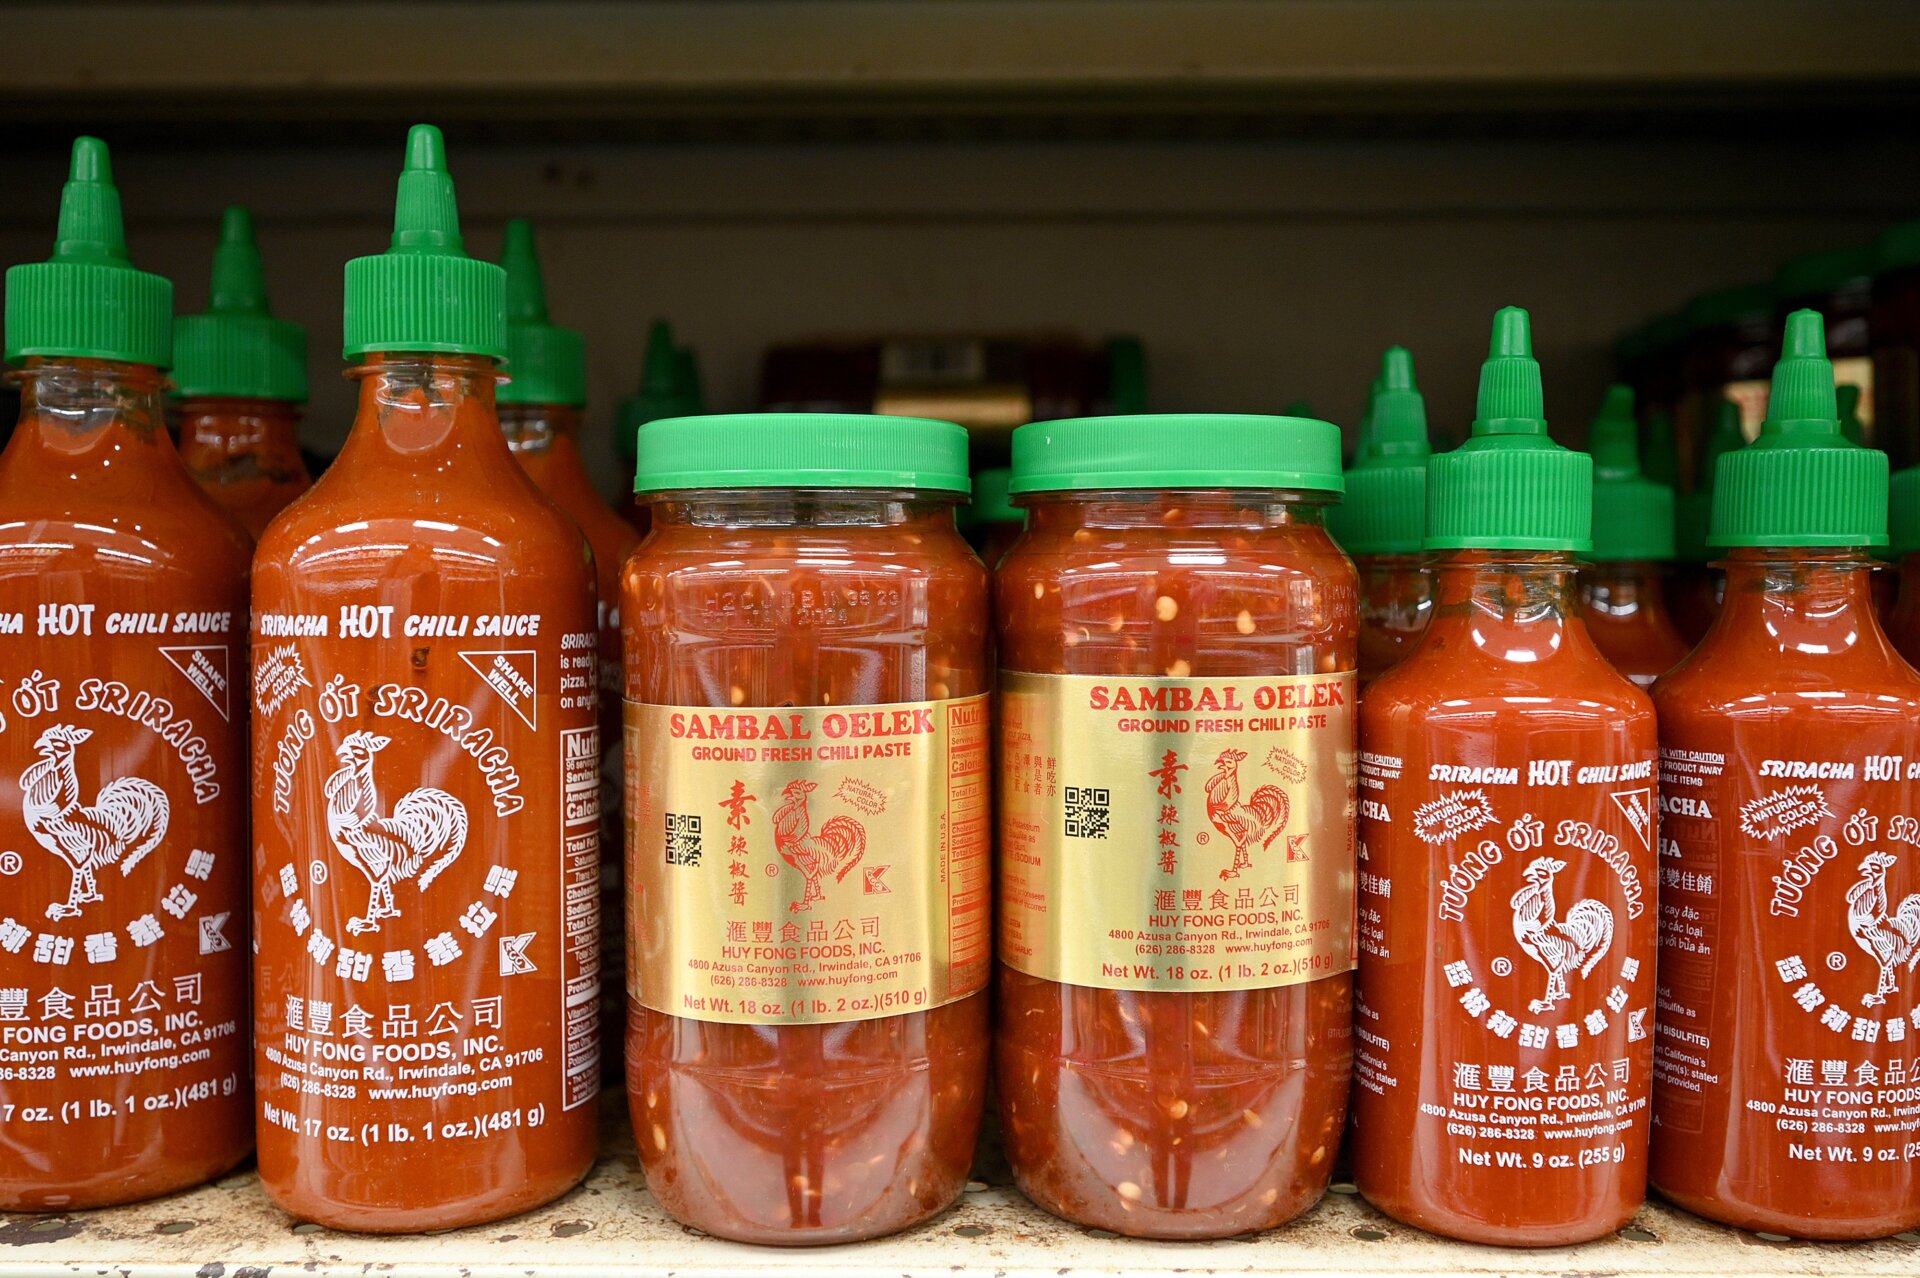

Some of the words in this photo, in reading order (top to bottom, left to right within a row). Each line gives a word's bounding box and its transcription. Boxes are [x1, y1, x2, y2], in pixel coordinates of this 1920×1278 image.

[37, 603, 95, 636] HOT
[105, 612, 169, 634] CHILI
[172, 611, 231, 633] SAUCE
[260, 614, 329, 637] SRIRACHA
[338, 604, 394, 639] HOT
[403, 615, 469, 637] CHILI
[472, 614, 541, 637] SAUCE
[560, 656, 569, 669] is
[493, 654, 534, 699] SHAKE
[487, 668, 521, 708] WELL
[1089, 686, 1244, 712] SAMBAL
[1253, 681, 1345, 710] OELEK
[560, 696, 574, 709] on
[669, 712, 812, 741] SAMBAL
[822, 708, 935, 738] OELEK
[1117, 718, 1191, 733] GROUND
[1195, 718, 1243, 733] FRESH
[1248, 717, 1285, 732] CHILI
[1288, 714, 1327, 730] PASTE
[76, 678, 220, 805] SRIRACHA
[374, 683, 525, 818] SRIRACHA
[692, 746, 757, 762] GROUND
[761, 746, 813, 762] FRESH
[816, 744, 860, 761] CHILI
[863, 742, 911, 758] PASTE
[1669, 749, 1687, 760] WITH
[1689, 752, 1725, 763] CAUTION
[1381, 769, 1400, 779] AWAY
[1429, 764, 1518, 784] SRIRACHA
[1528, 760, 1572, 786] HOT
[1577, 766, 1620, 784] CHILI
[1620, 760, 1652, 782] SAUCE
[1664, 762, 1697, 773] PRODUCT
[1699, 765, 1723, 776] AWAY
[1759, 759, 1855, 780] SRIRACHA
[1864, 755, 1903, 781] HOT
[1680, 776, 1703, 787] ITEMS
[566, 789, 592, 803] Amount
[1423, 802, 1467, 828] NATURAL
[1446, 806, 1481, 829] COLOR
[1751, 796, 1803, 823] NATURAL
[1778, 801, 1818, 825] COLOR
[1555, 820, 1644, 920] SRIRACHA
[566, 901, 592, 916] Sodium
[1149, 915, 1180, 928] HUY
[1183, 914, 1226, 928] FONG
[1228, 912, 1278, 928] FOODS,
[1281, 909, 1304, 922] INC.
[1665, 905, 1680, 918] cay
[1681, 905, 1700, 921] đặc
[566, 918, 587, 932] Total
[1108, 929, 1134, 940] 4800
[1137, 931, 1172, 942] Azusa
[1175, 931, 1219, 944] Canyon
[1246, 926, 1293, 940] Irwindale,
[1668, 918, 1684, 933] các
[1686, 922, 1703, 938] loại
[722, 946, 751, 960] HUY
[754, 947, 797, 960] FONG
[800, 944, 856, 960] FOODS,
[859, 942, 886, 955] INC.
[1134, 944, 1163, 956] (626)
[1166, 944, 1216, 955] 286-8328
[1225, 937, 1313, 954] www.huyfong.com
[1698, 940, 1710, 955] ăn
[688, 959, 709, 971] 4800
[711, 962, 744, 973] Azusa
[746, 963, 789, 976] Canyon
[819, 958, 873, 973] Irwindale,
[874, 956, 891, 968] CA
[892, 952, 922, 965] 91706
[1101, 962, 1129, 979] Net
[1133, 964, 1160, 981] Wt.
[1166, 966, 1185, 980] 18
[1189, 967, 1213, 981] oz.
[567, 980, 591, 995] Protein
[710, 975, 735, 988] (626)
[738, 977, 788, 988] 286-8328
[797, 969, 898, 988] www.huyfong.com
[684, 994, 706, 1011] Net
[709, 998, 734, 1013] Wt.
[738, 1000, 757, 1015] 18
[762, 1003, 786, 1016] oz.
[811, 999, 832, 1014] lb.
[1658, 998, 1684, 1015] Bisulfite
[1686, 1008, 1696, 1018] as
[3, 1025, 67, 1045] FONG
[73, 1018, 159, 1042] FOODS,
[165, 1010, 203, 1031] INC.
[1663, 1025, 1710, 1049] BISULFITE)
[0, 1048, 58, 1064] Canyon
[101, 1038, 177, 1058] Irwindale,
[180, 1030, 201, 1046] CA
[204, 1021, 236, 1041] 91706
[284, 1032, 310, 1058] HUY
[312, 1041, 366, 1063] FONG
[372, 1041, 458, 1063] FOODS,
[463, 1034, 504, 1057] INC.
[1358, 1027, 1390, 1051] BISULFITE)
[69, 1048, 211, 1078] www.huyfong.com
[281, 1053, 308, 1074] Azusa
[309, 1062, 358, 1083] Canyon
[362, 1067, 394, 1082] Rd.,
[399, 1063, 476, 1081] Irwindale,
[479, 1056, 503, 1073] CA
[504, 1048, 543, 1068] 91706
[1361, 1078, 1384, 1095] provided.
[1376, 1073, 1397, 1087] stated
[1667, 1075, 1702, 1093] provided.
[1691, 1069, 1718, 1084] stated
[301, 1081, 356, 1099] 286-8328
[368, 1075, 513, 1103] www.huyfong.com
[1453, 1092, 1489, 1109] HUY
[1494, 1096, 1542, 1111] FONG
[1547, 1094, 1603, 1110] FOODS,
[1607, 1088, 1629, 1105] INC.
[1784, 1088, 1822, 1103] HUY
[1826, 1090, 1873, 1105] FONG
[22, 1107, 54, 1122] oz.
[89, 1099, 117, 1118] lb.
[1420, 1102, 1446, 1117] 4800
[1449, 1110, 1486, 1123] Azusa
[1489, 1113, 1537, 1126] Canyon
[1566, 1107, 1613, 1124] Irwindale,
[1746, 1099, 1776, 1114] 4800
[1779, 1105, 1818, 1118] Azusa
[1822, 1107, 1868, 1121] Canyon
[263, 1101, 280, 1125] Net
[281, 1111, 300, 1134] Wt.
[304, 1119, 321, 1138] 17
[327, 1124, 355, 1143] oz.
[388, 1121, 416, 1143] lb.
[1447, 1123, 1476, 1139] (626)
[1480, 1126, 1535, 1140] 286-8328
[1544, 1118, 1633, 1140] www.huyfong.com
[1776, 1119, 1808, 1134] (626)
[1811, 1122, 1865, 1134] 286-8328
[1459, 1147, 1491, 1167] Net
[1496, 1151, 1526, 1168] Wt.
[1549, 1155, 1574, 1168] oz.
[1578, 1148, 1610, 1169] (255
[1789, 1143, 1822, 1161] Net
[1827, 1145, 1857, 1162] Wt.
[1877, 1148, 1900, 1161] oz.
